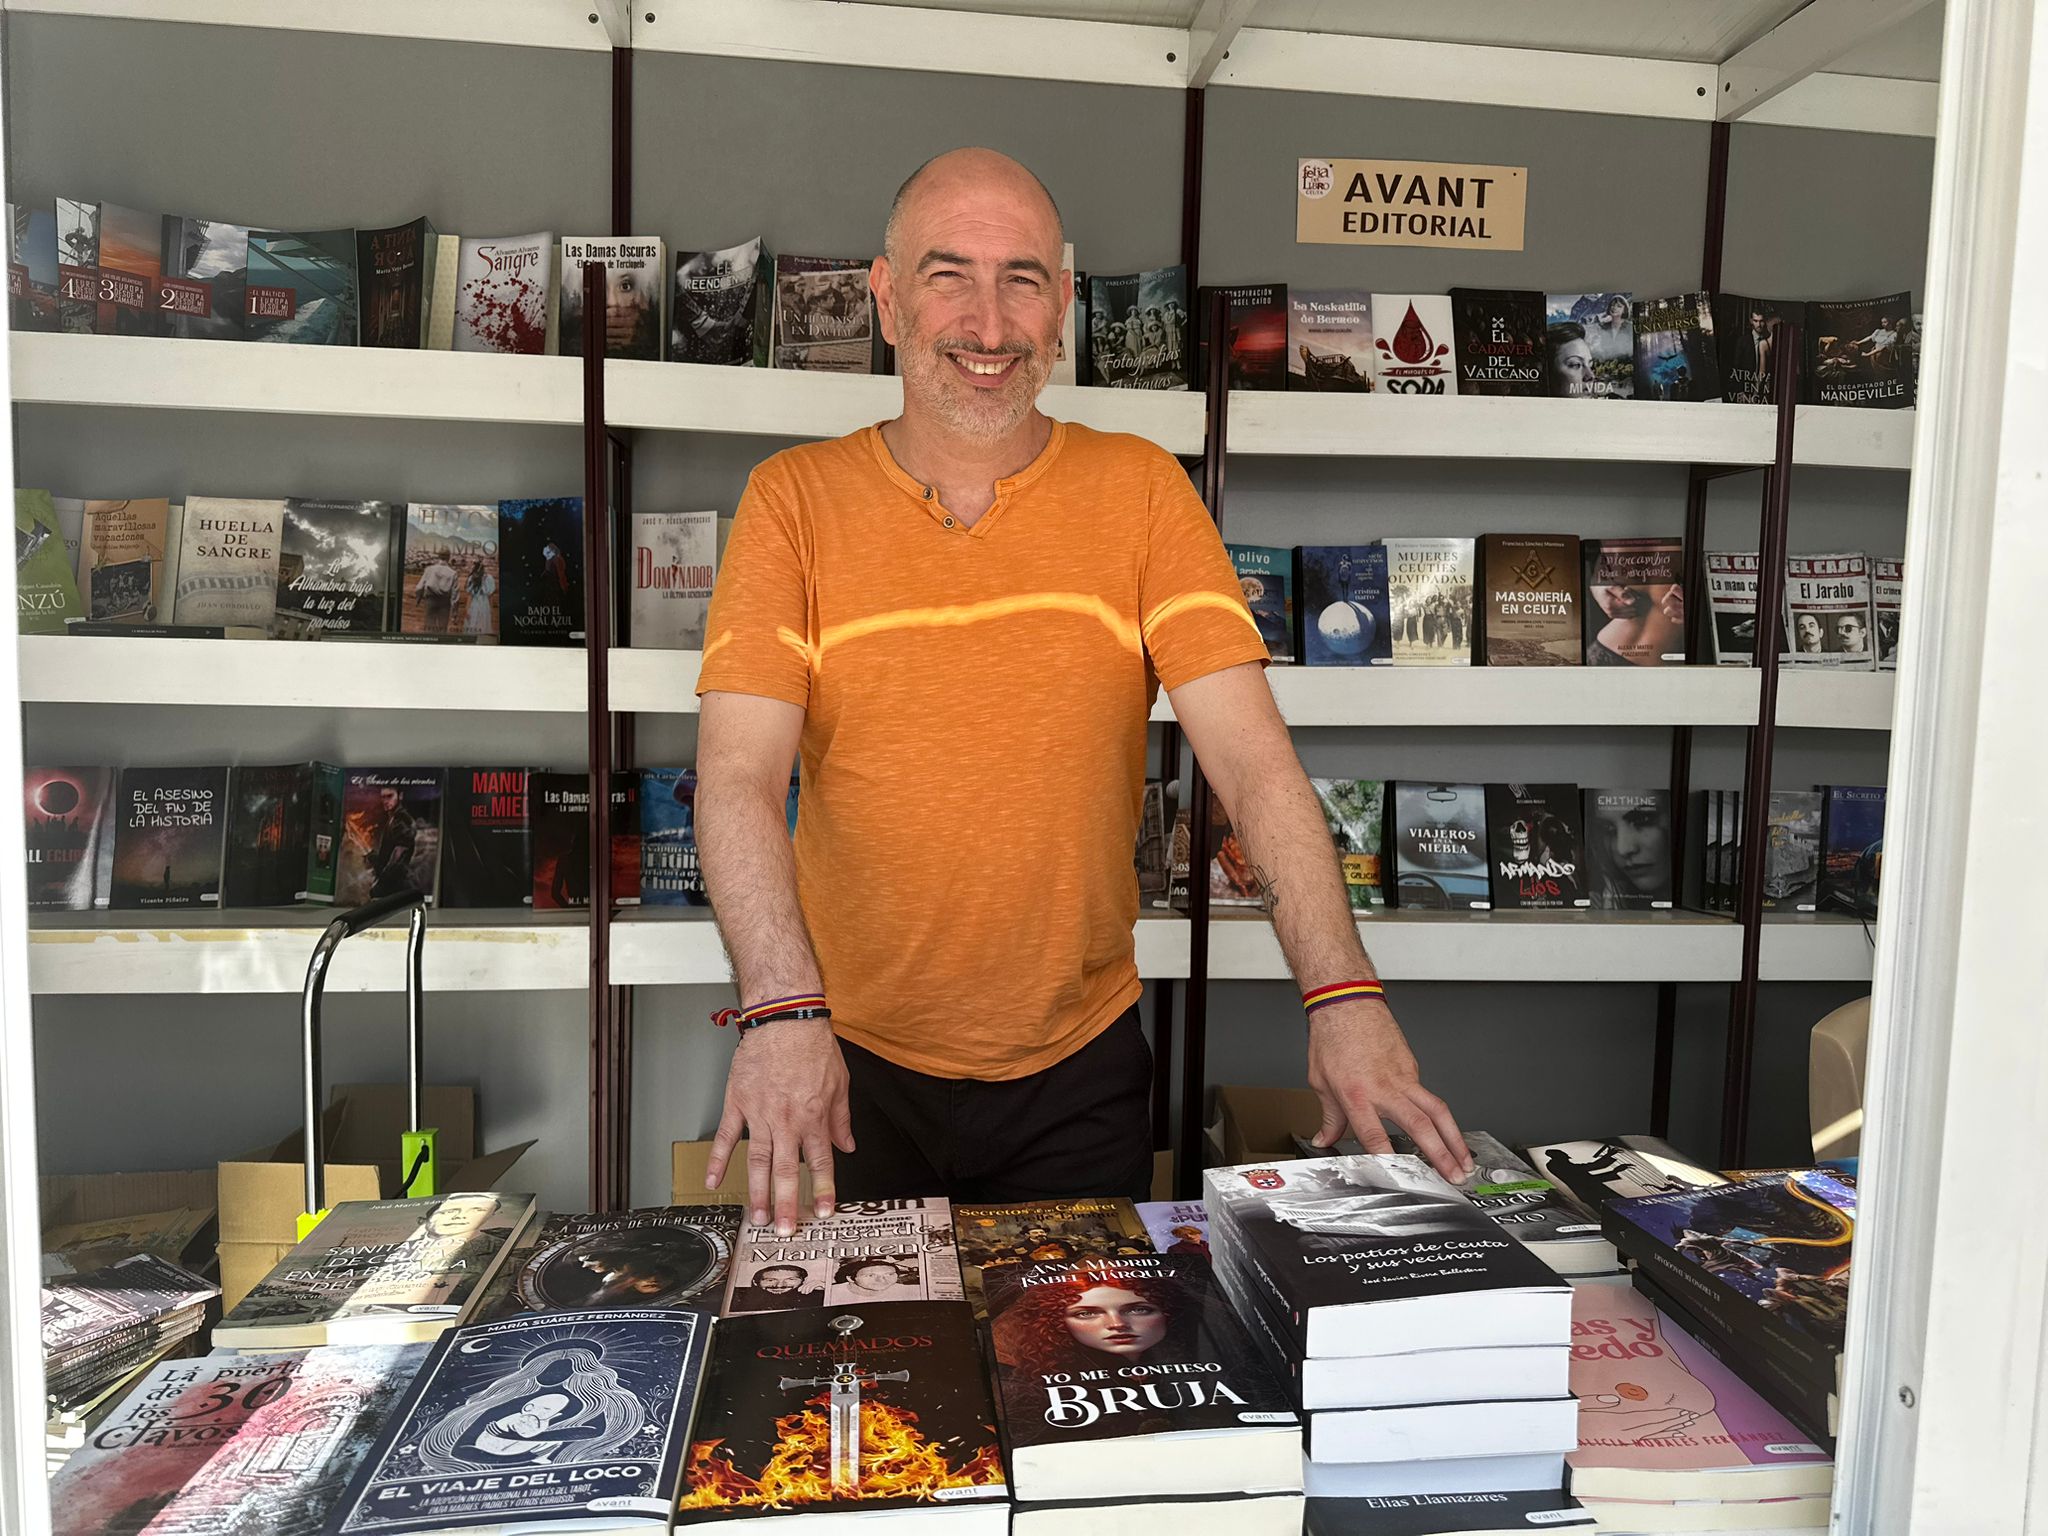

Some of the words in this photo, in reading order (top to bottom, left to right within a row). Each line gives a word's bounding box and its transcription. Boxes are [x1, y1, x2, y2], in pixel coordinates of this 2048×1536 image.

[1343, 172, 1495, 210] AVANT
[1342, 211, 1492, 240] EDITORIAL
[565, 243, 584, 259] Las
[586, 244, 617, 258] Damas
[619, 244, 657, 259] Oscuras
[477, 246, 540, 281] Sangre
[61, 278, 76, 299] 4
[99, 279, 114, 301] 3
[160, 288, 176, 310] 2
[250, 296, 258, 315] 1
[1293, 301, 1308, 314] La
[1309, 302, 1367, 315] Neskatilla
[1300, 316, 1315, 327] de
[1316, 316, 1360, 327] Bermeo
[1492, 330, 1509, 343] EL
[1488, 356, 1515, 368] DEL
[1464, 364, 1540, 380] VATICANO
[1585, 382, 1614, 394] VIDA
[1744, 382, 1759, 393] EN
[1820, 384, 1905, 402] MANDEVILLE
[1837, 380, 1884, 392] DECAPITADO
[1886, 378, 1898, 387] DE
[94, 512, 138, 526] Aquellas
[93, 523, 157, 537] maravillosas
[199, 520, 275, 535] HUELLA
[93, 534, 146, 547] vacaciones
[224, 535, 250, 550] DE
[196, 547, 273, 564] SANGRE
[1238, 551, 1272, 565] olivo
[1397, 551, 1459, 563] MUJERES
[1790, 560, 1812, 574] EL
[348, 576, 374, 597] bajo
[1388, 574, 1468, 585] OLVIDADAS
[1711, 578, 1721, 591] La
[1495, 590, 1574, 604] MASONERÍA
[1800, 583, 1811, 599] El
[302, 595, 315, 611] la
[316, 597, 335, 615] luz
[336, 597, 356, 612] del
[1501, 604, 1522, 615] EN
[1523, 604, 1569, 616] CEUTA
[133, 790, 150, 802] EL
[153, 788, 214, 802] ASESINO
[545, 790, 560, 804] Las
[562, 791, 590, 804] Damas
[133, 802, 160, 815] DEL
[165, 803, 187, 814] FIN
[194, 801, 212, 813] DE
[472, 805, 489, 818] DEL
[129, 815, 146, 829] LA
[151, 812, 213, 828] HISTORIA
[1409, 827, 1476, 842] VIAJEROS
[1418, 842, 1469, 855] NIEBLA
[1499, 858, 1576, 880] ARMANDO
[959, 1207, 1029, 1217] Secretos
[1055, 1202, 1117, 1213] Cabaret
[560, 1225, 569, 1234] A
[627, 1219, 643, 1230] DE
[652, 1217, 668, 1227] TU
[673, 1214, 727, 1225] REFLEJO
[839, 1214, 913, 1226] Martutene
[805, 1227, 882, 1243] fuga
[892, 1221, 937, 1236] de
[325, 1237, 468, 1257] SANITARIOS
[751, 1240, 945, 1263] Martutene
[1302, 1253, 1339, 1267] Los
[1339, 1245, 1410, 1266] patios
[1412, 1242, 1442, 1254] de
[1443, 1240, 1510, 1253] Ceuta
[327, 1256, 363, 1268] DE
[1024, 1262, 1080, 1281] ANNA
[1085, 1258, 1161, 1272] MADRID
[1347, 1263, 1361, 1275] y
[1366, 1258, 1404, 1272] sus
[1404, 1250, 1485, 1268] vecinos
[285, 1269, 320, 1281] EN
[324, 1268, 355, 1280] LA
[1020, 1272, 1078, 1288] ISABEL
[1381, 1273, 1409, 1285] Javier
[1409, 1271, 1440, 1281] Rivera
[309, 1279, 356, 1292] DEL
[487, 1323, 531, 1335] MARÍA
[532, 1314, 587, 1330] SUÁREZ
[587, 1309, 668, 1323] FERNÁNDEZ
[1618, 1317, 1657, 1342] y
[756, 1335, 934, 1360] QUEMADOS
[1041, 1372, 1072, 1385] YO
[1080, 1368, 1111, 1381] ME
[1117, 1361, 1223, 1378] CONFIESO
[1043, 1379, 1251, 1428] BRUJA
[1632, 1436, 1700, 1449] MORALES
[378, 1484, 415, 1501] EL
[421, 1477, 502, 1497] VIAJE
[508, 1471, 563, 1491] DEL
[568, 1464, 644, 1485] LOCO
[465, 1490, 521, 1505] INTERNACIONAL
[555, 1486, 569, 1496] DEL
[1366, 1492, 1410, 1510] Elías
[1413, 1491, 1509, 1508] Llamazares
[428, 1503, 448, 1515] PARA
[481, 1499, 509, 1511] PADRES
[515, 1497, 540, 1508] OTROS
[539, 1493, 577, 1505] CURIOSOS
